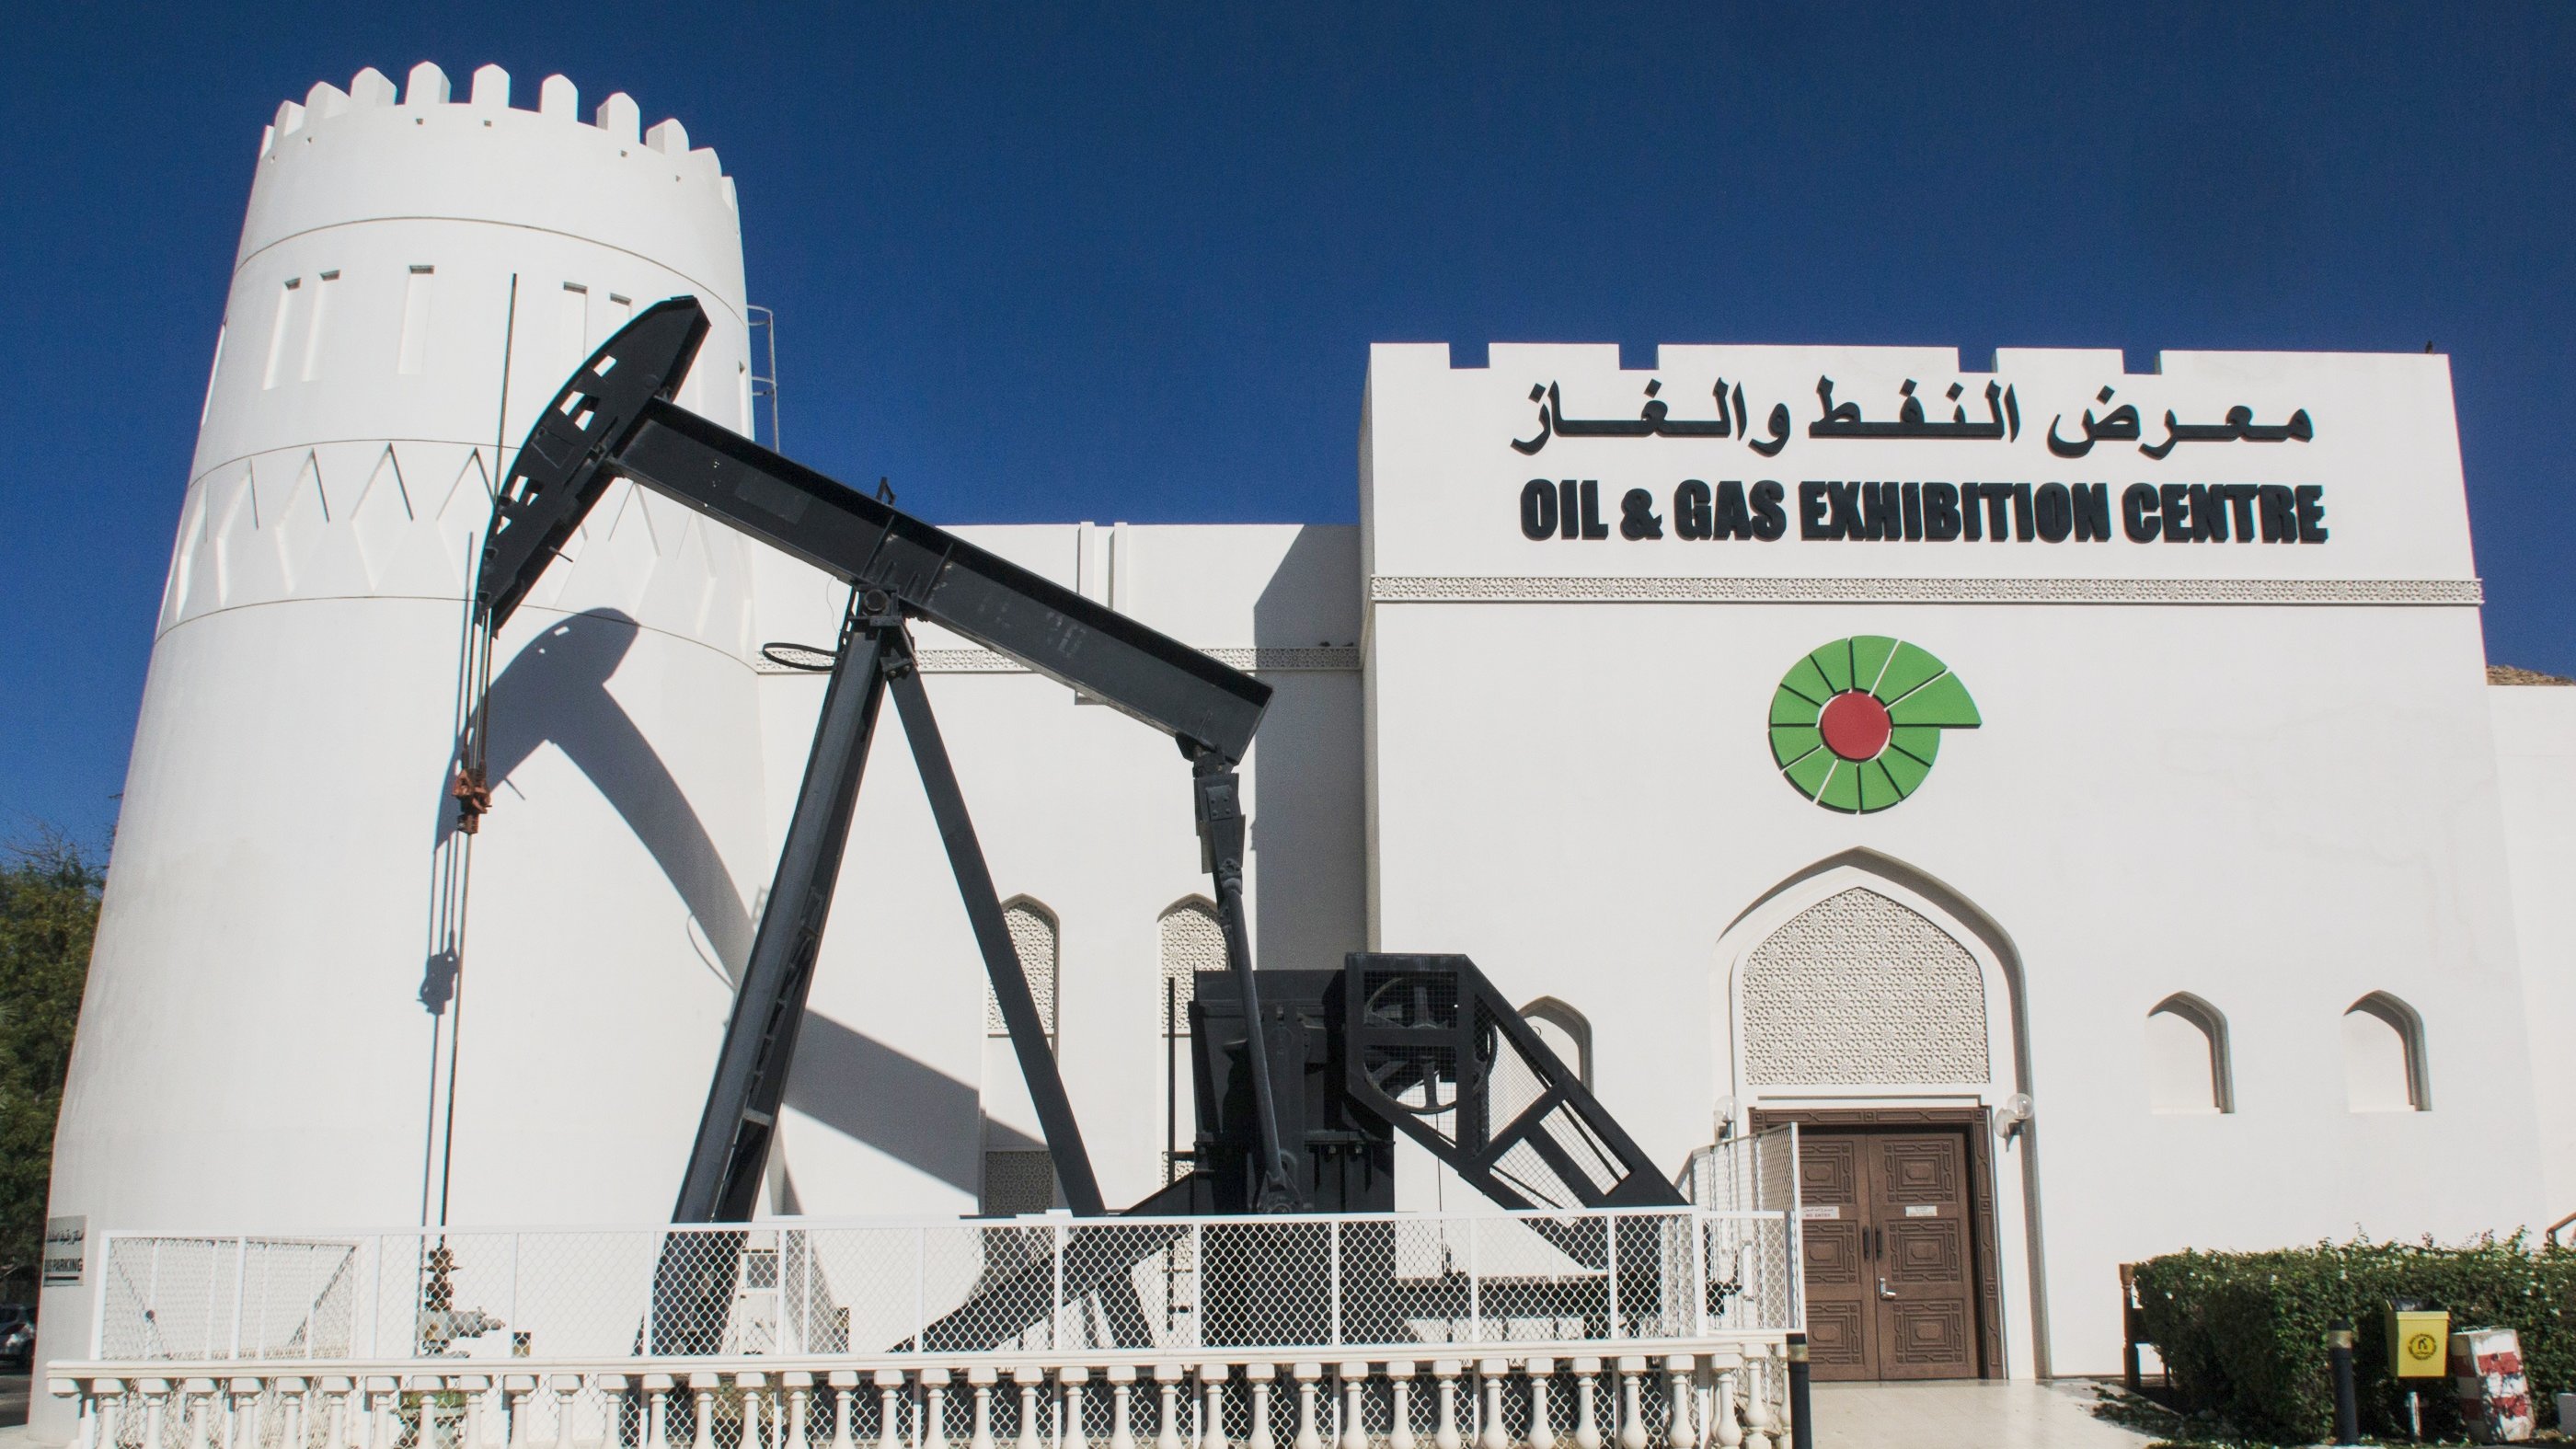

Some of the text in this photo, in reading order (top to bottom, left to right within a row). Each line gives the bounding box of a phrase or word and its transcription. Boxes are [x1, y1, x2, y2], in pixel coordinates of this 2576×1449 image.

[1510, 374, 2313, 460] معرض النفط والغاز
[1520, 478, 2329, 544] OIL & GAS EXHIBITION CENTRE
[52, 1258, 83, 1272] PARKING
